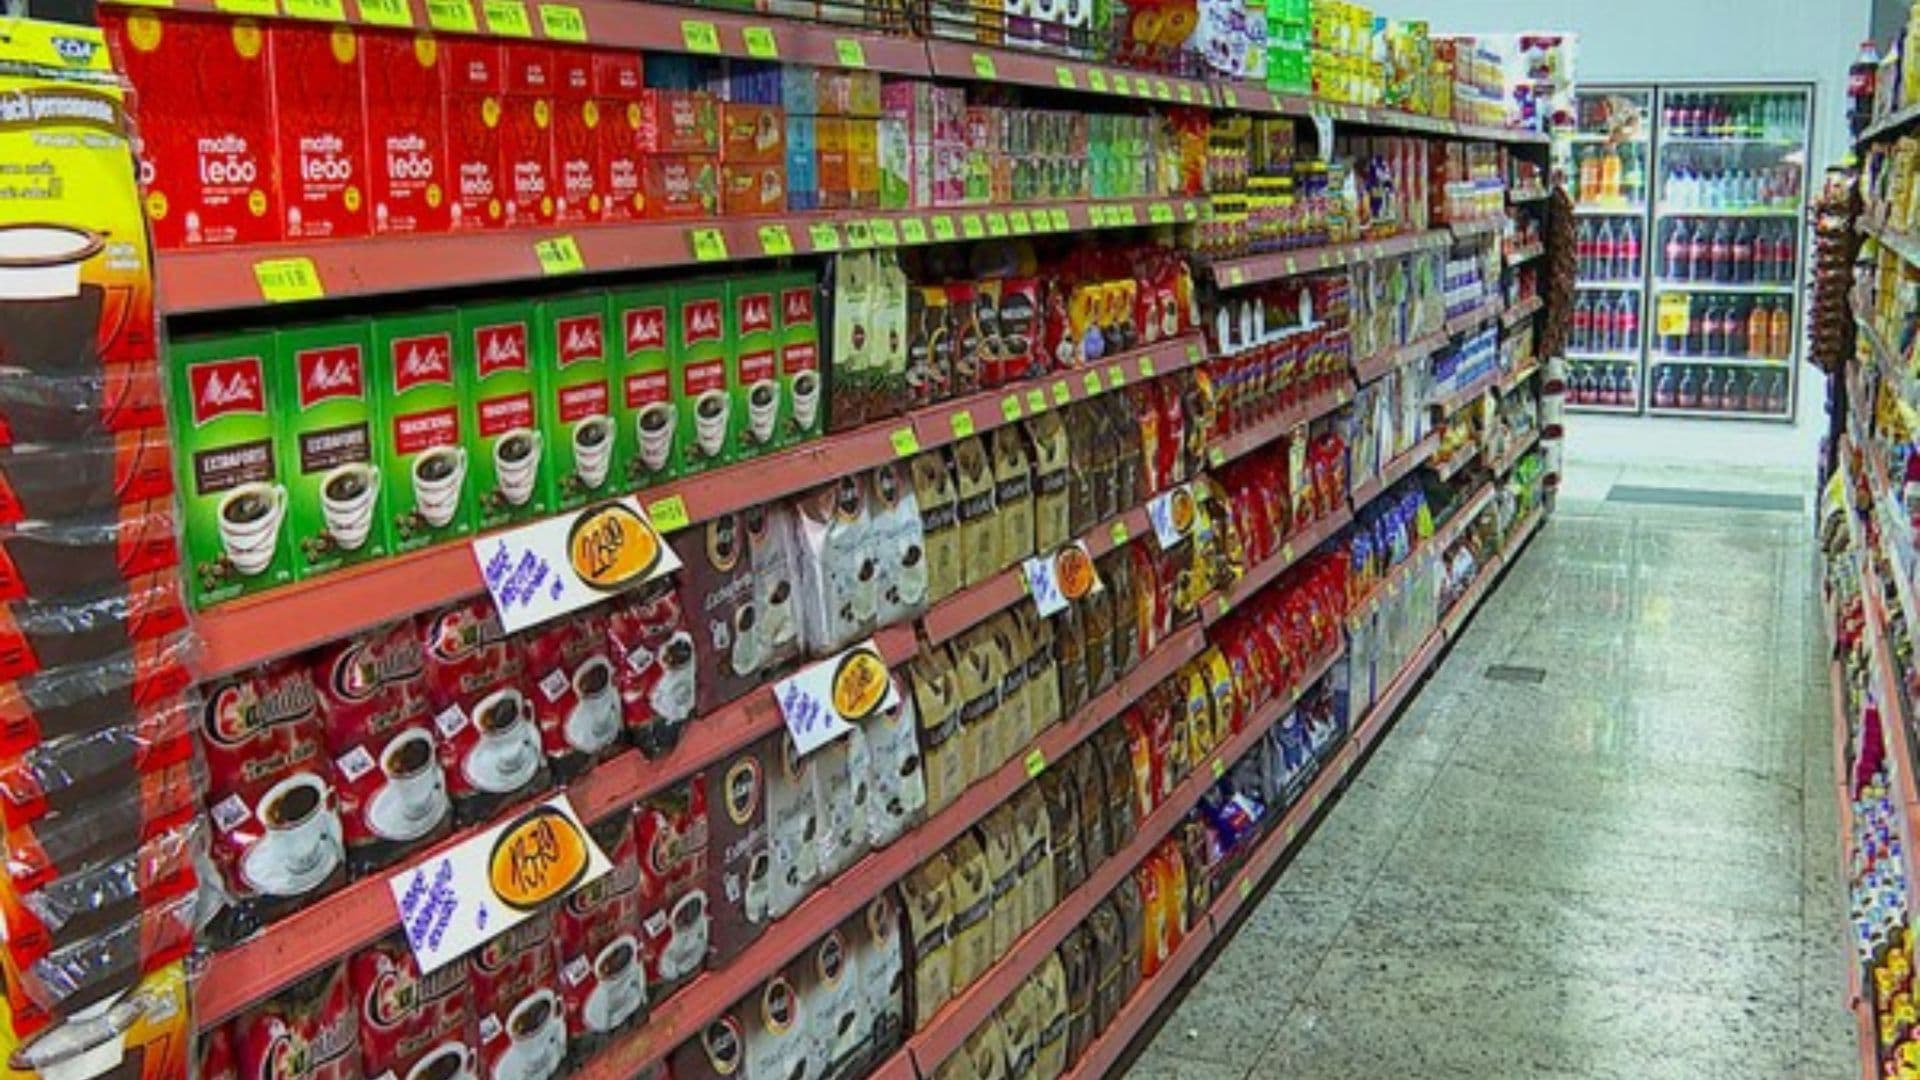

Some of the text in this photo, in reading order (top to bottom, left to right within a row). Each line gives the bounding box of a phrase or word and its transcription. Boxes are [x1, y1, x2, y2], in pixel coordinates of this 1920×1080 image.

[200, 154, 256, 184] leão
[301, 153, 352, 179] leão
[388, 152, 433, 179] leão
